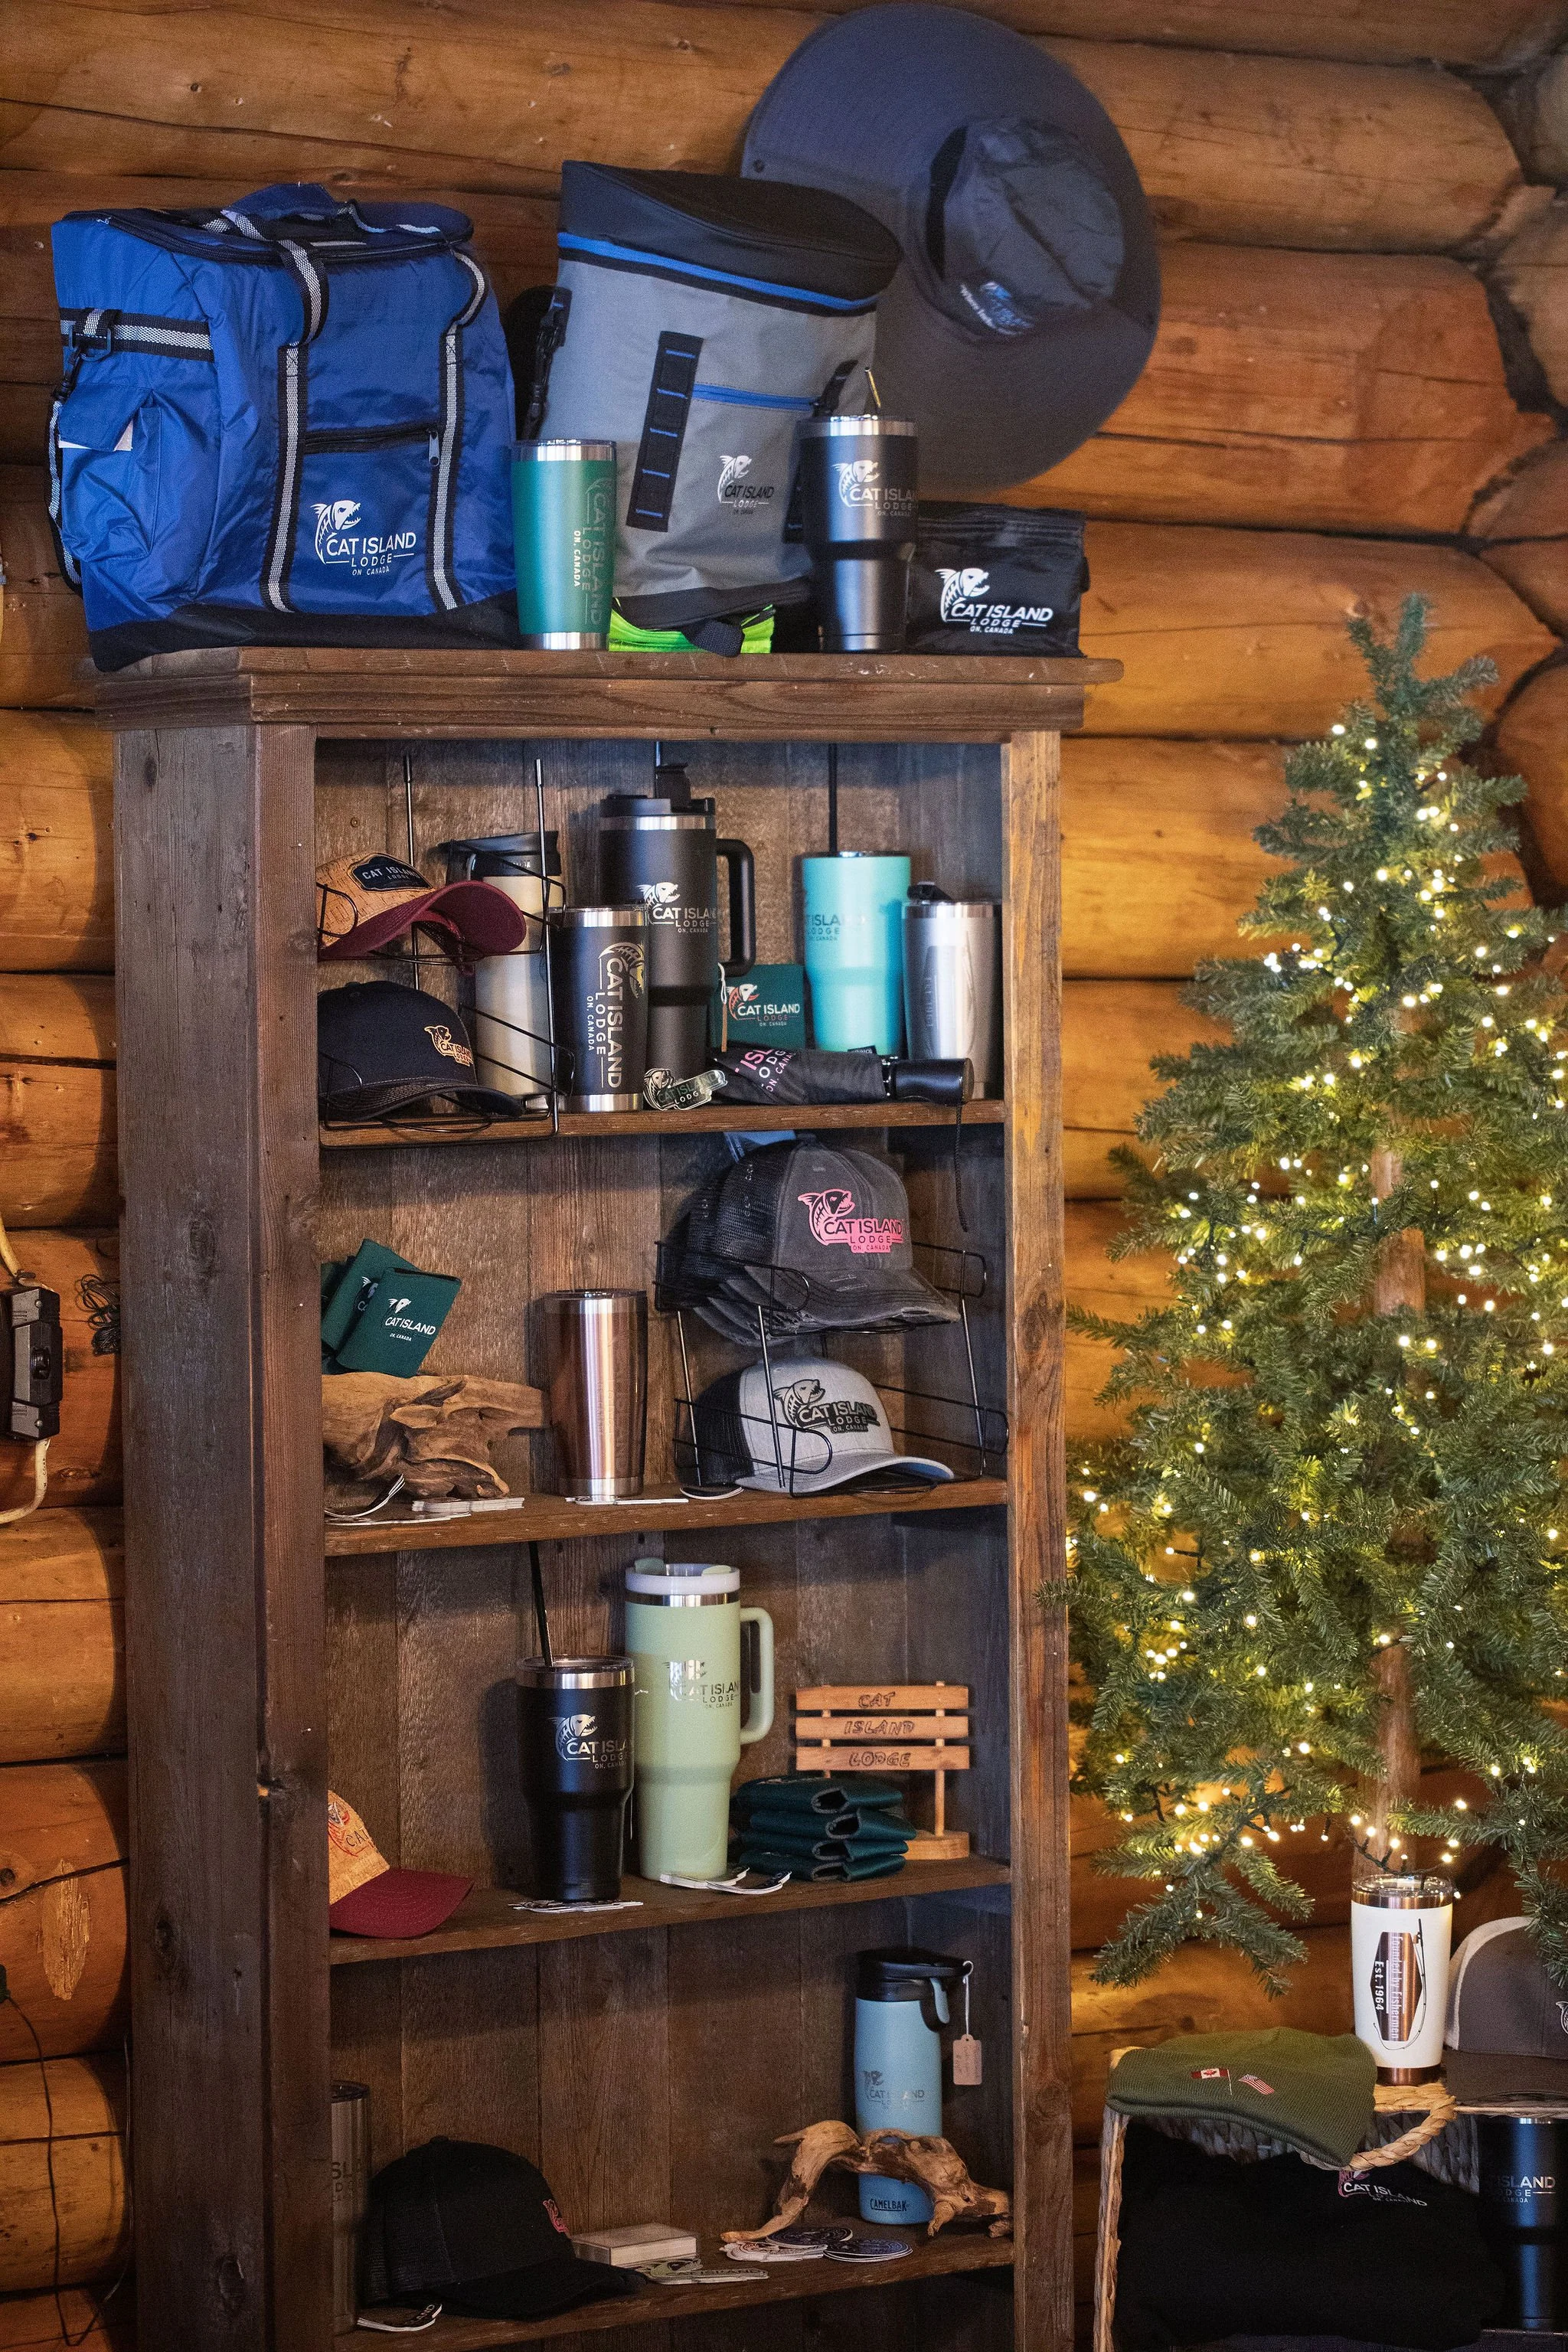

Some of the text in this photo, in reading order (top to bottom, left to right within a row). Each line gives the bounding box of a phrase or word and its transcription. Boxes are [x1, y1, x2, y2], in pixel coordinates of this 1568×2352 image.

[724, 485, 775, 499] CAT ISLAND
[849, 488, 881, 501] CAT
[875, 501, 912, 510] LODGE
[326, 532, 416, 556] CAT ISLAND
[351, 554, 392, 567] LODGE
[582, 527, 592, 591] LODGE
[590, 492, 606, 625] CAT ISLAND
[367, 566, 390, 576] CANADA
[951, 603, 1054, 622] CAT ISLAND
[970, 618, 1022, 628] LODGE
[985, 626, 1014, 635] CANADA
[361, 867, 420, 880] CAT ISLAND
[652, 907, 681, 920] CAT
[737, 1003, 801, 1016] CAT ISLAND
[595, 992, 606, 1055] LODGE
[607, 958, 623, 1088] CAT ISLAND
[586, 1014, 595, 1051] CANADA
[440, 1043, 454, 1052] CAT
[658, 1090, 675, 1102] CAT
[824, 1220, 903, 1235] CAT ISLAND
[850, 1235, 891, 1243] LODGE
[385, 1316, 436, 1335] CAT ISLAND
[799, 1402, 876, 1423] CAT ISLAND
[828, 1416, 867, 1426] LODGE
[858, 1690, 896, 1708] CAT
[844, 1720, 915, 1735] ISLAND
[567, 1741, 599, 1755] CAT
[848, 1751, 911, 1767] LODGE
[1374, 1961, 1384, 2011] Est. 1964
[869, 2089, 886, 2099] CAT
[1344, 2182, 1370, 2192] CAT
[1374, 2185, 1428, 2206] ISLAND
[870, 2198, 907, 2211] CAMELBAK
